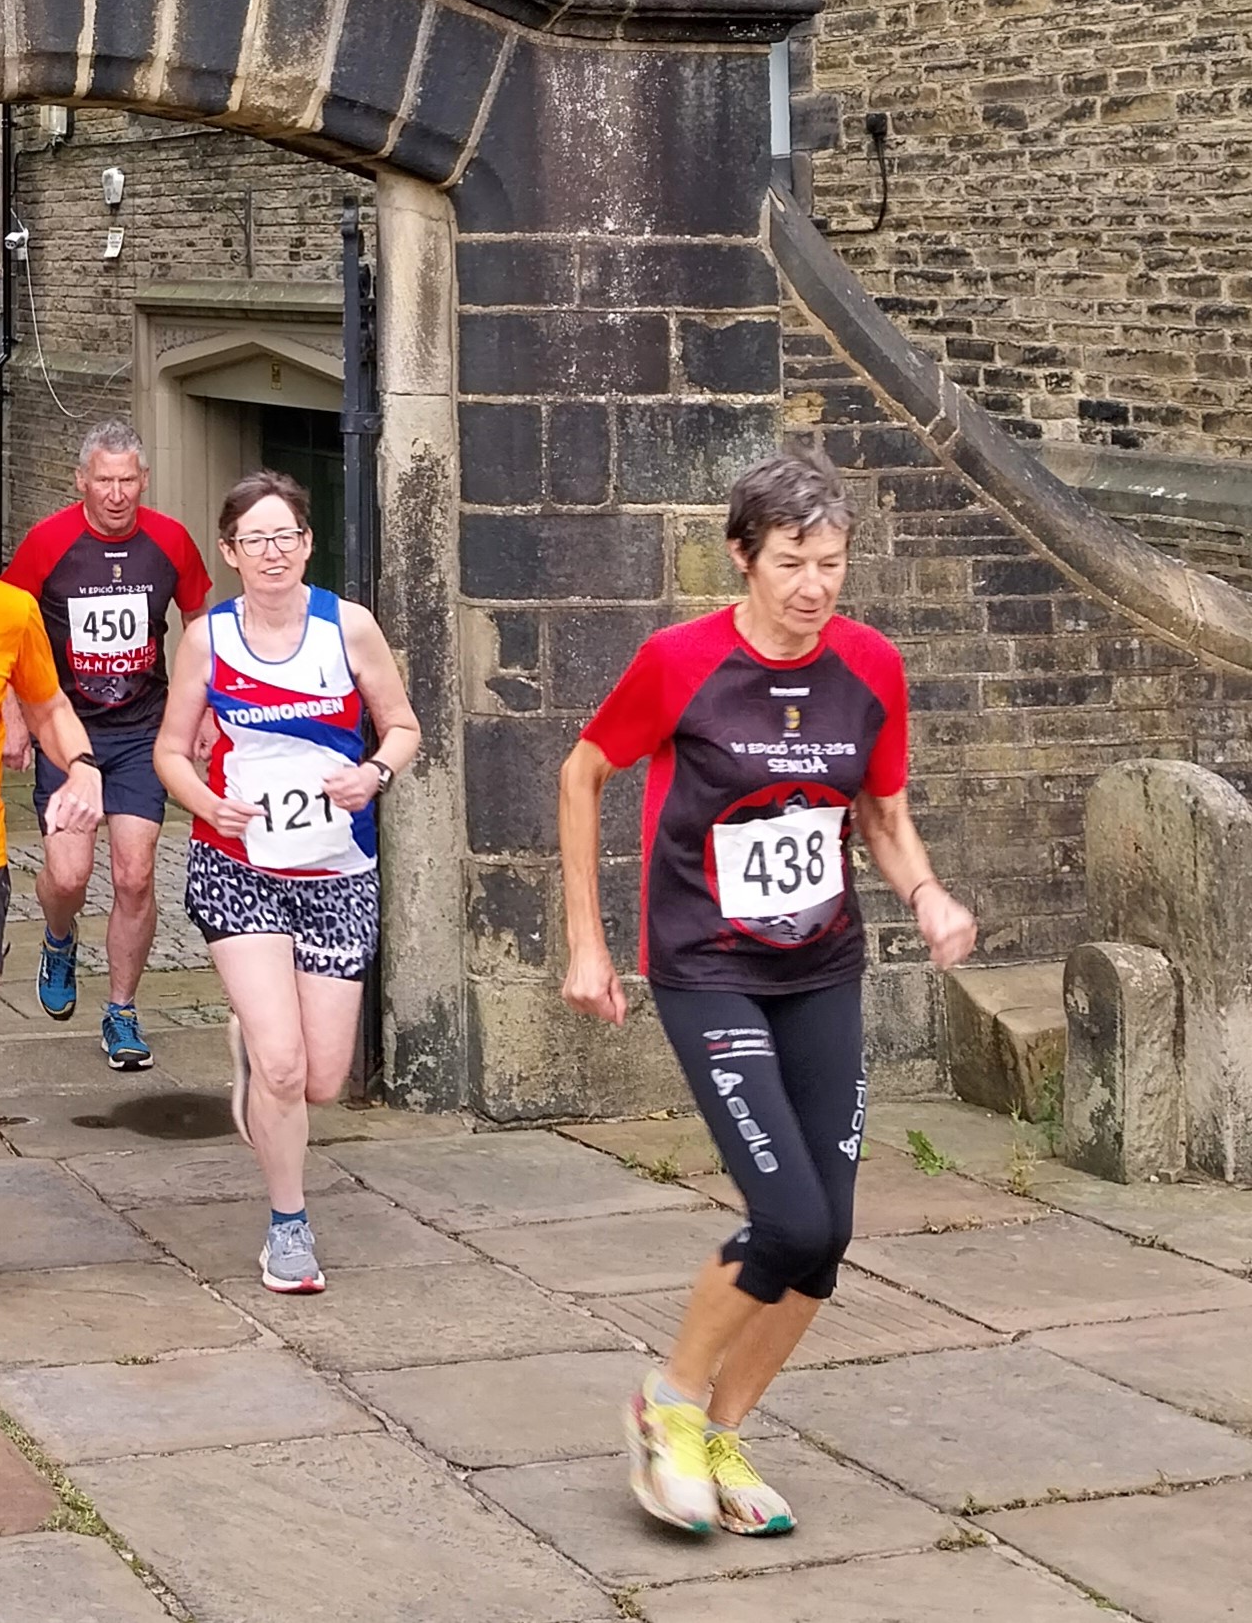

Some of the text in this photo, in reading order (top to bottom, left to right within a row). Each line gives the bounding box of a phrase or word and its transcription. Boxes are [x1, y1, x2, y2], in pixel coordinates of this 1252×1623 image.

[82, 608, 136, 642] 450
[226, 697, 345, 725] TODMORDEN
[254, 788, 334, 833] 121
[743, 829, 825, 897] 438
[726, 1096, 780, 1173] odlo
